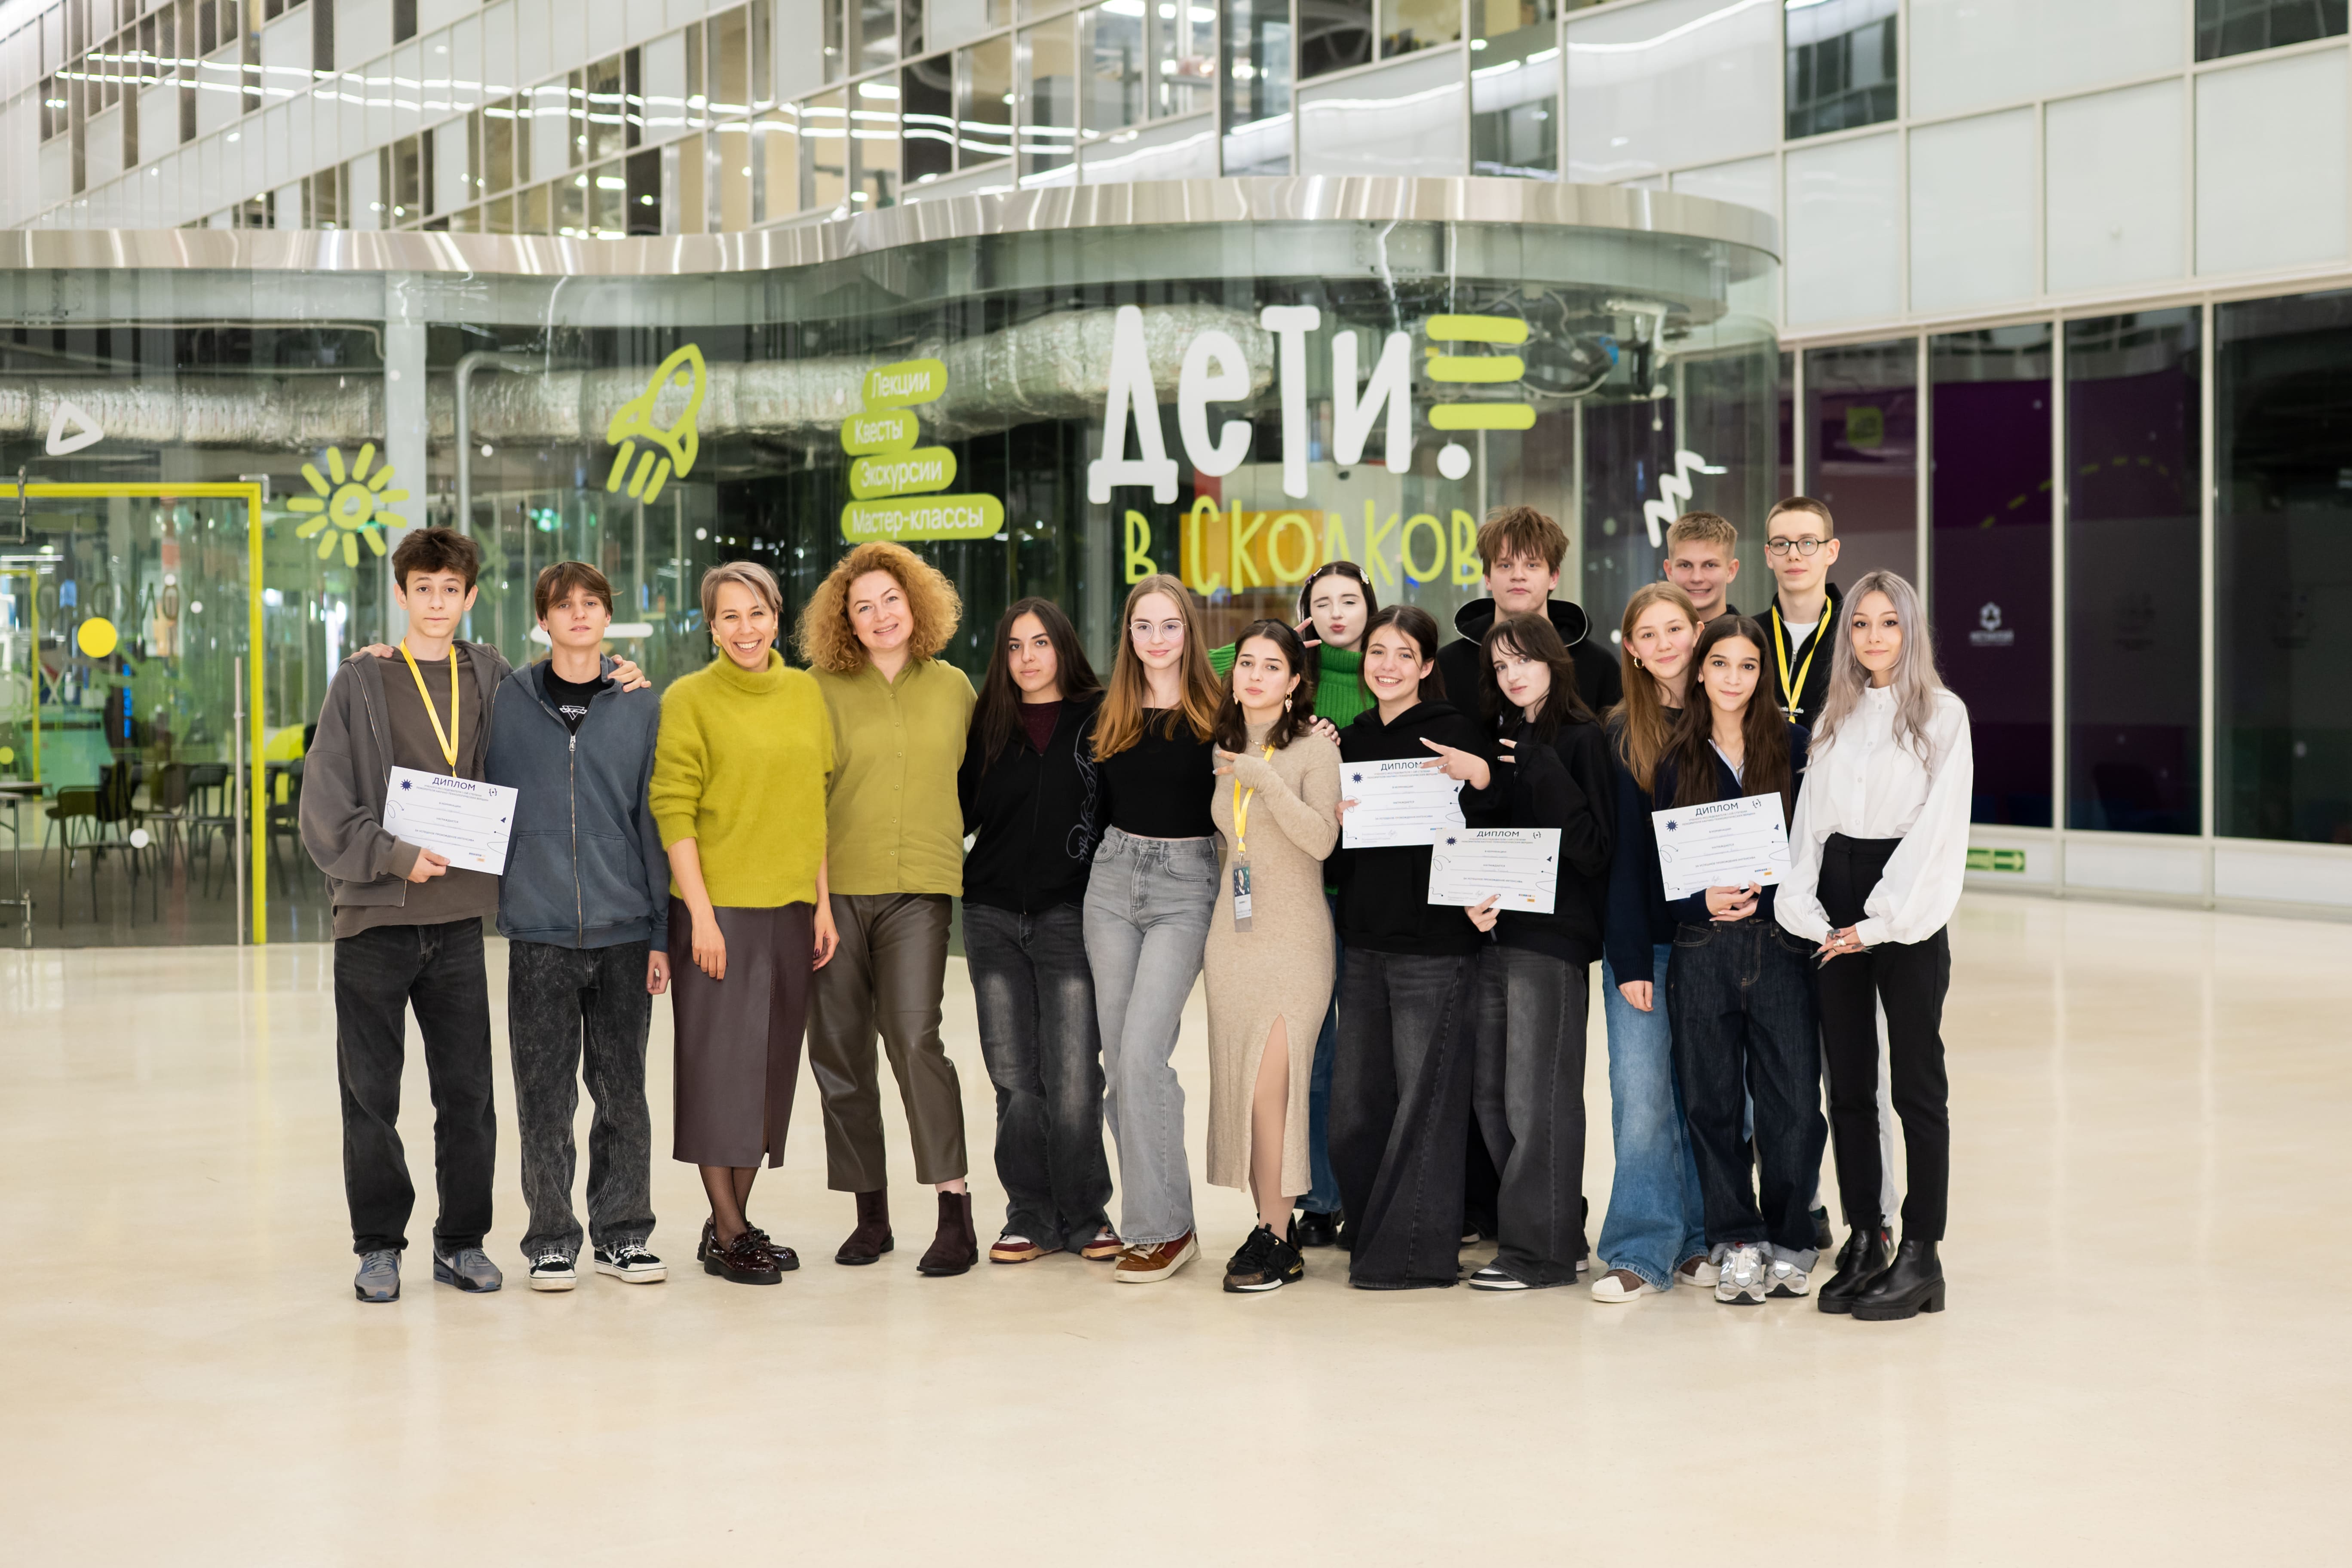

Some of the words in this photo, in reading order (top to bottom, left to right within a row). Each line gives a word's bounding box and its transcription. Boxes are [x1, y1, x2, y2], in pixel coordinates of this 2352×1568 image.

[871, 371, 930, 399] Лекции
[854, 419, 903, 445] Квесты
[861, 460, 942, 492] Экскурсии
[852, 506, 984, 538] Мастер-классы
[432, 777, 475, 791] ДИПЛОМ
[1696, 802, 1739, 816] ДИПЛОМ
